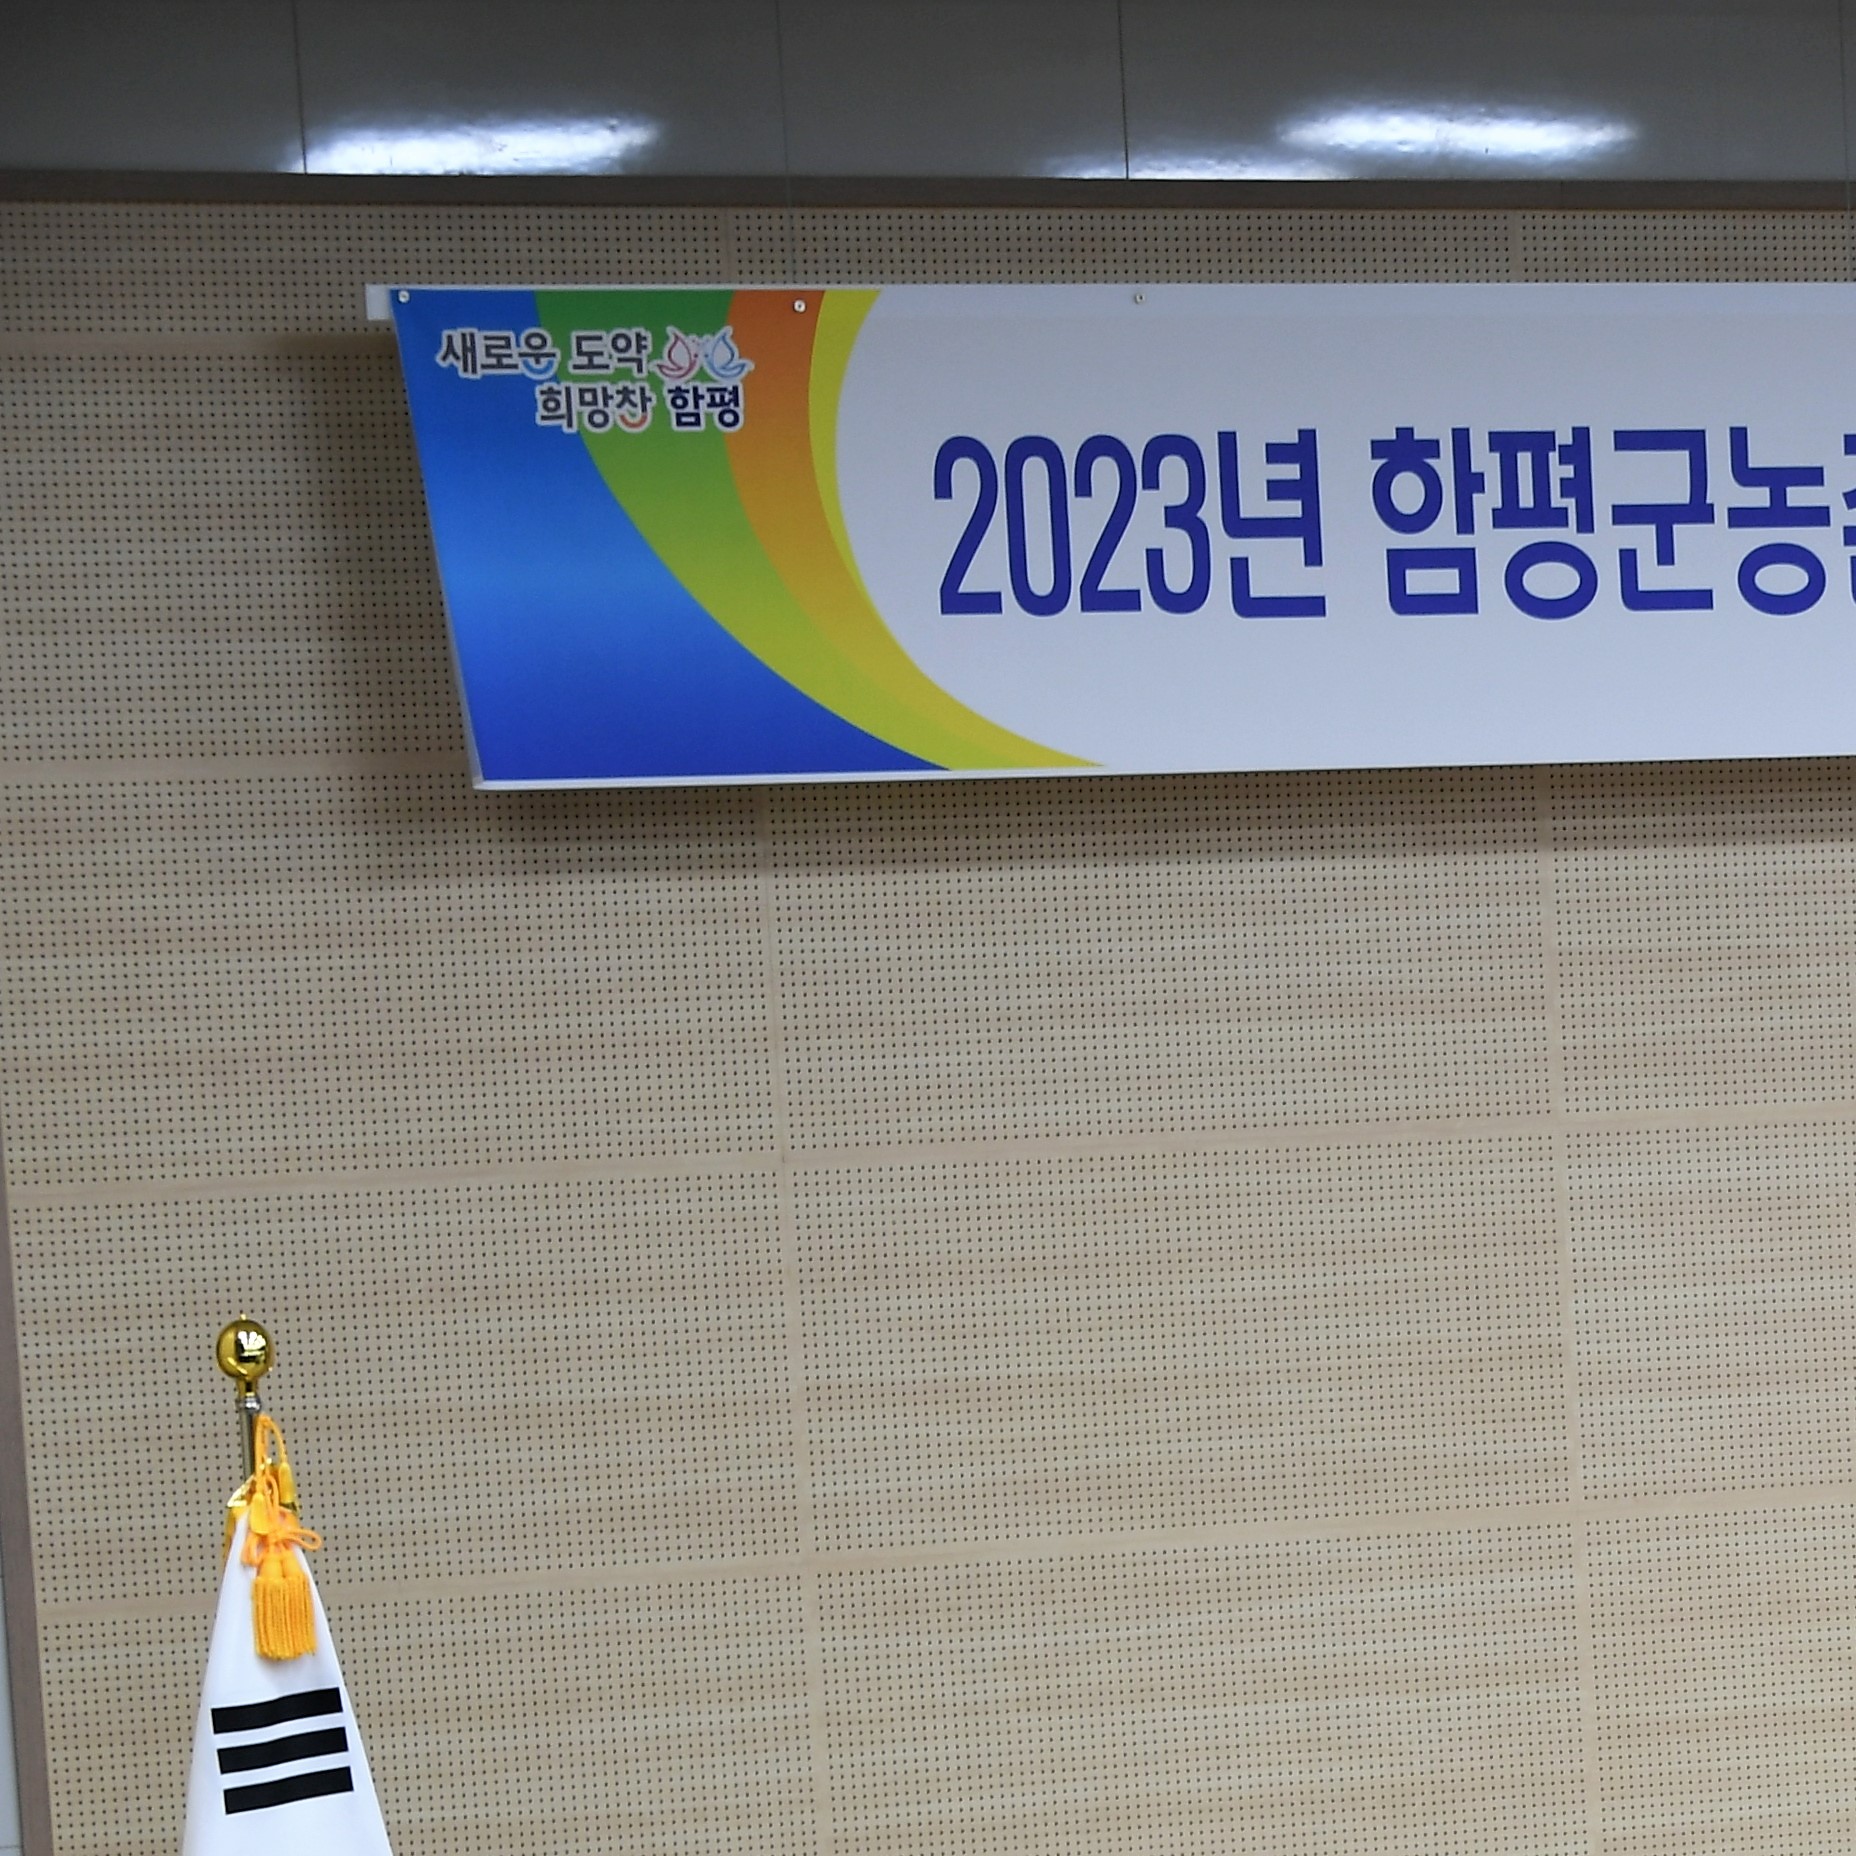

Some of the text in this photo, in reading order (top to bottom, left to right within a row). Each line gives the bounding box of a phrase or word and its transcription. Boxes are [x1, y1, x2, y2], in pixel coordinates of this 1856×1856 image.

[440, 332, 649, 378] 새로운 도약
[538, 385, 741, 429] 희망찬 함평
[934, 428, 1328, 621] 2023년
